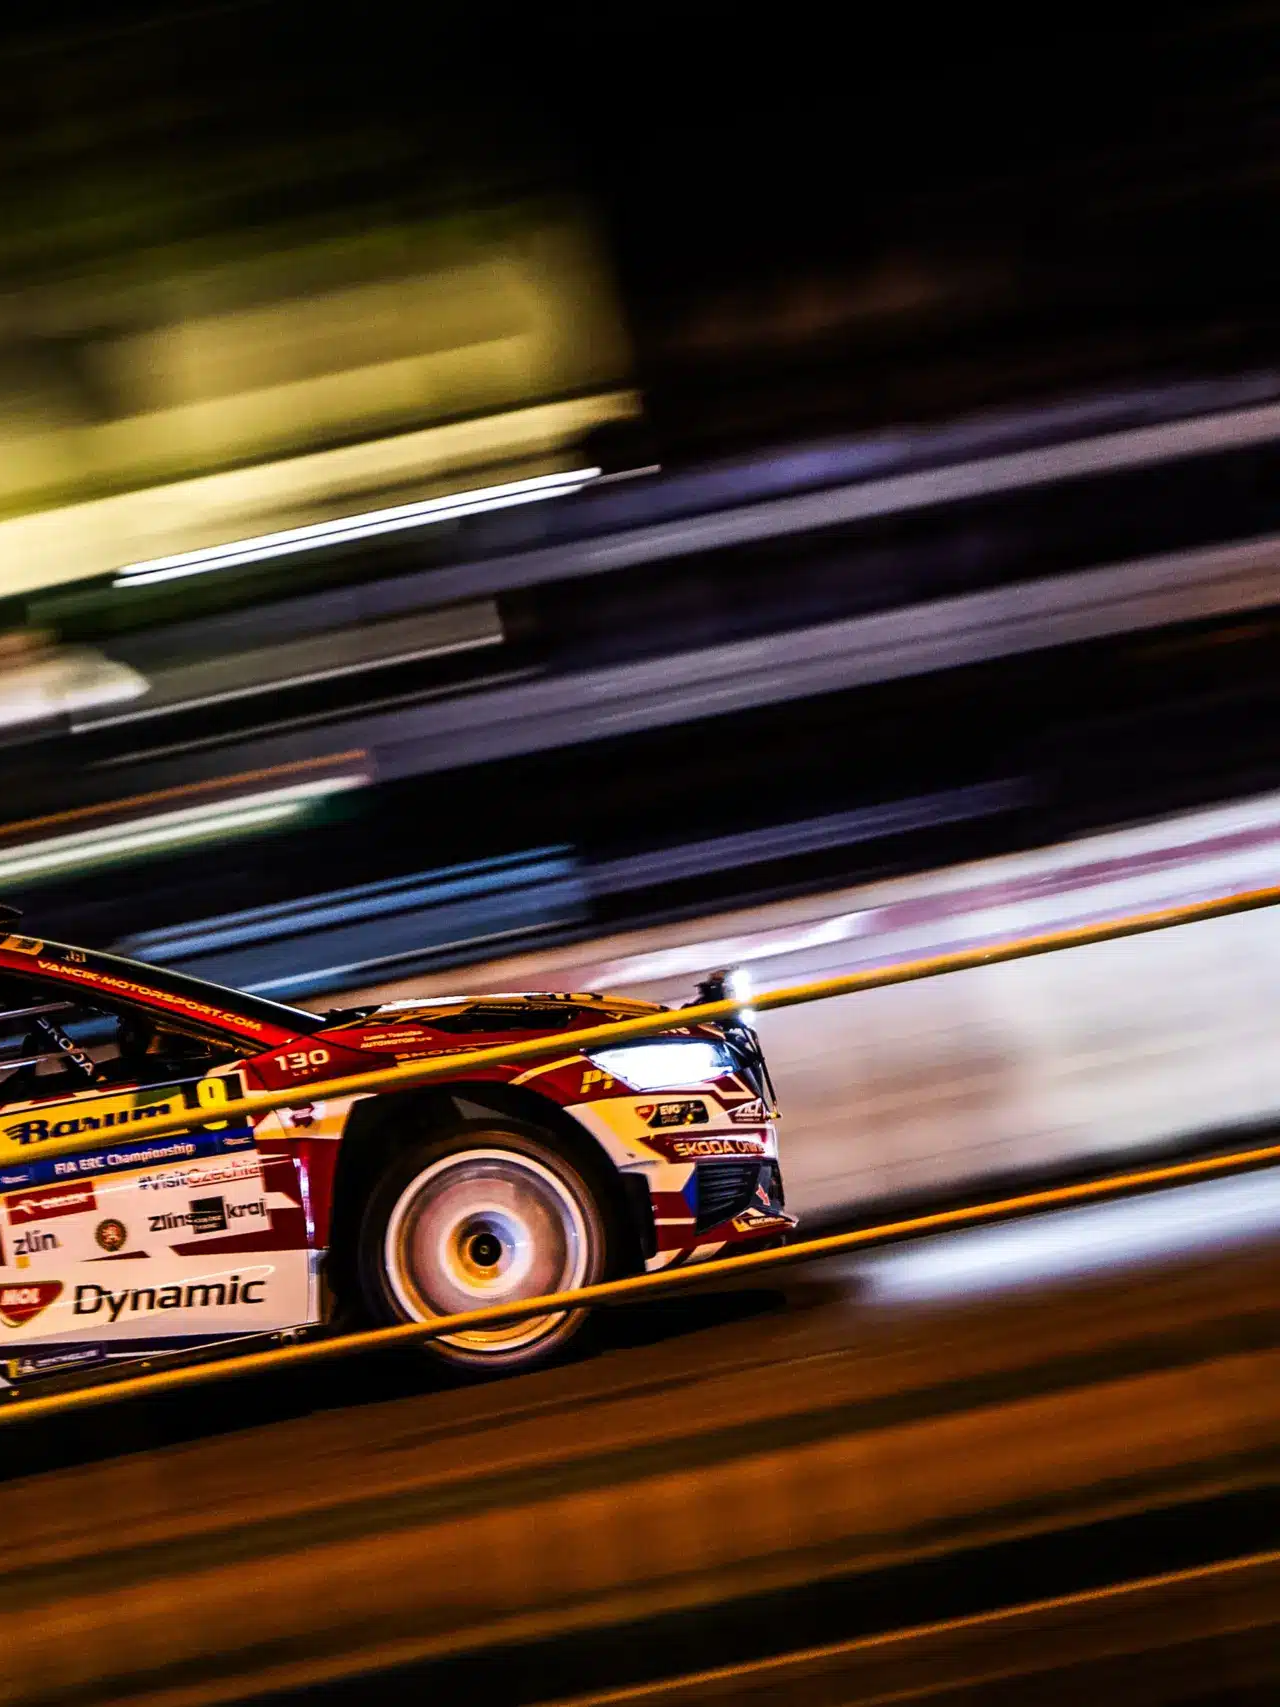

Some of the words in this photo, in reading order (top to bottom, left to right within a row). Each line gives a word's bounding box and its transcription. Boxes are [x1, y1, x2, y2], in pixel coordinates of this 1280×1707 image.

[274, 1047, 330, 1072] 130
[54, 1162, 78, 1175] FIA
[79, 1156, 105, 1171] ERC
[107, 1143, 197, 1165] Championship
[72, 1276, 268, 1322] Dynamic
